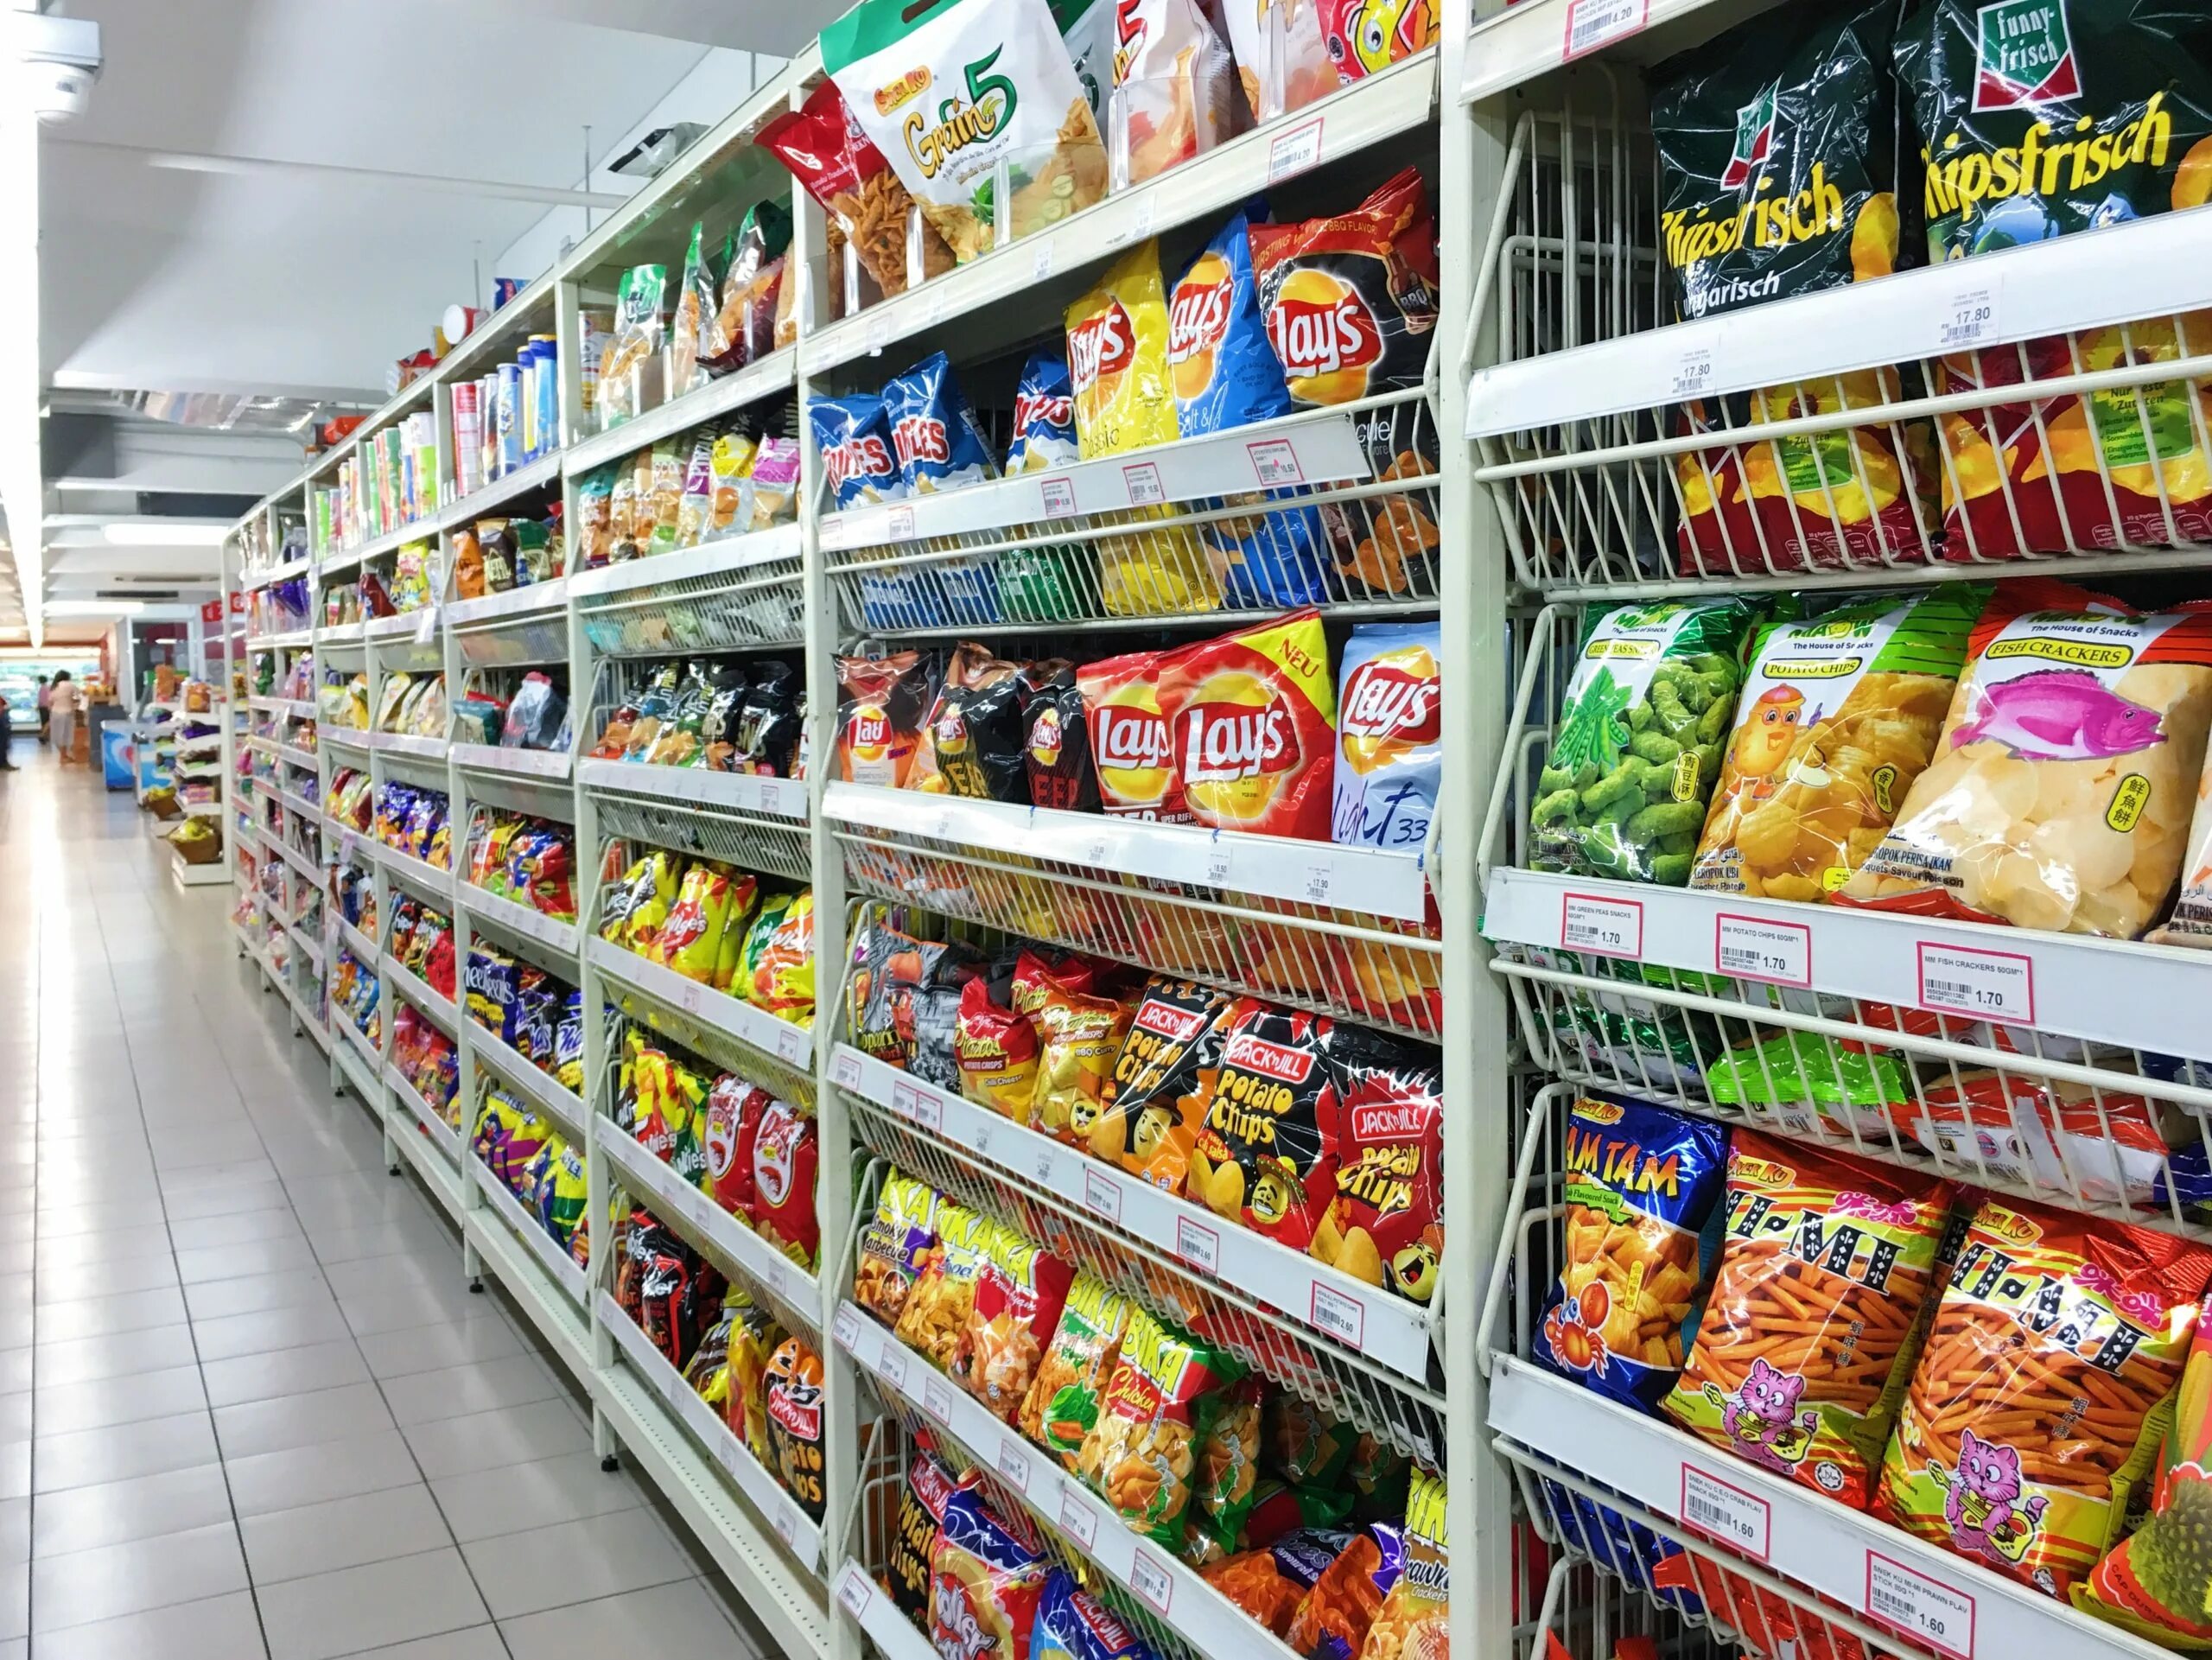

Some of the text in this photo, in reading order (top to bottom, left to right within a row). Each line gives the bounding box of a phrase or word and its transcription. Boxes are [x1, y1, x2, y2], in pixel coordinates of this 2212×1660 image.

[1612, 7, 1632, 22] 4.20
[1999, 35, 2058, 73] frisch
[902, 111, 996, 179] Grain
[1255, 234, 1291, 272] URSTING
[1398, 288, 1428, 309] BBQ
[1955, 307, 1991, 324] 17.80
[1272, 299, 1363, 378] Lay's
[1683, 363, 1710, 378] 17.80
[2117, 396, 2164, 410] Zutten
[1201, 407, 1211, 428] &
[2085, 626, 2099, 634] of
[2101, 627, 2139, 638] Snacks
[1280, 638, 1320, 679] NEU
[1992, 641, 2122, 663] FISH CRACKERS
[1821, 662, 1857, 674] CHIPS
[1343, 665, 1439, 737] Lay's
[1185, 703, 1284, 785] Lay's
[2113, 779, 2145, 826] 鮮魚餅
[1313, 878, 1329, 889] 17.90
[1891, 865, 1923, 881] Saveur
[1610, 910, 1630, 919] SNACKS
[1601, 931, 1620, 944] 1.70
[1733, 927, 1757, 937] POTATO
[1764, 956, 1785, 970] 1.70
[1937, 957, 1954, 966] FISH
[1955, 960, 1995, 972] CRACKERS
[1976, 989, 2003, 1006] 1.70
[1095, 1046, 1117, 1058] Curry
[1217, 1069, 1294, 1115] Potato
[1211, 1097, 1277, 1145] Chips
[1602, 1141, 1680, 1199] TAM
[1336, 1164, 1413, 1212] Chips
[1573, 1188, 1618, 1205] Flavoured Snack
[865, 1236, 910, 1262] arbecue
[1120, 1307, 1191, 1395] BIKA
[1106, 1365, 1156, 1414] Chicken
[1688, 1482, 1707, 1496] SNACK
[1730, 1494, 1745, 1506] CRAB
[1732, 1518, 1754, 1538] 1.60
[1873, 1574, 1892, 1588] STICK
[2111, 1563, 2128, 1590] CAP
[1873, 1564, 1891, 1579] SNEK
[1923, 1587, 1948, 1606] PRAWN
[1949, 1600, 1967, 1614] FLAV
[1919, 1612, 1945, 1635] 1.60
